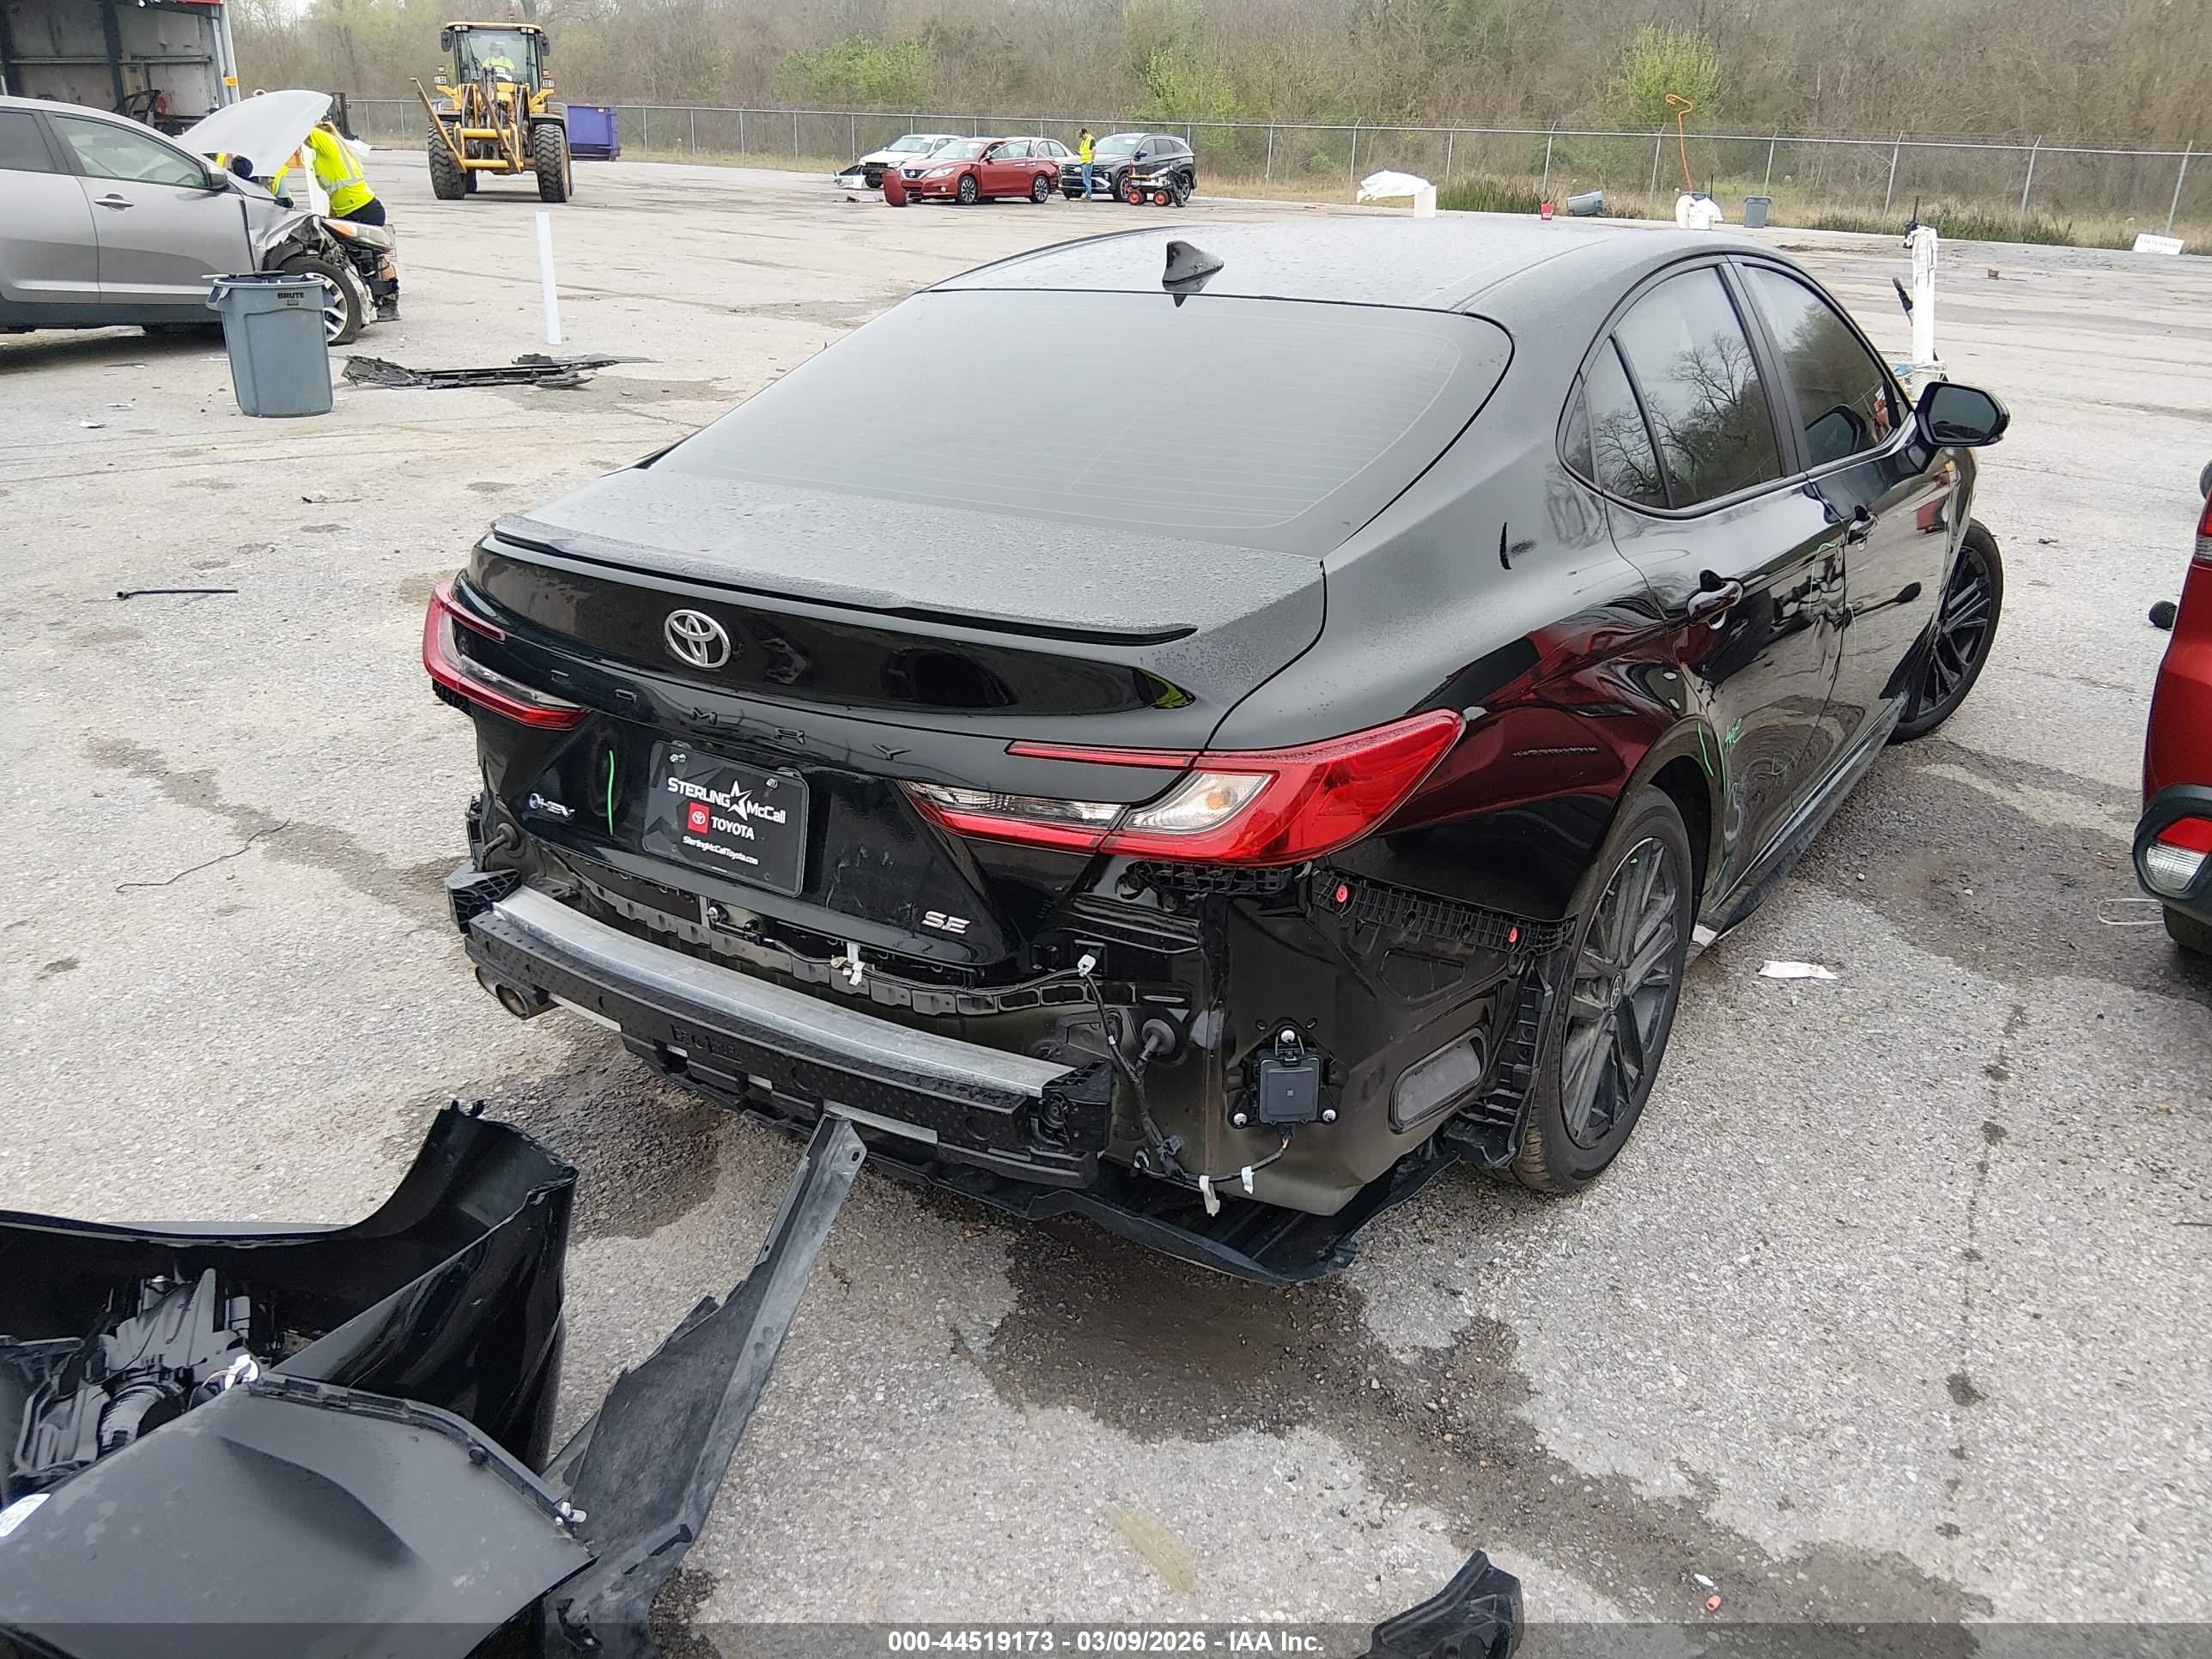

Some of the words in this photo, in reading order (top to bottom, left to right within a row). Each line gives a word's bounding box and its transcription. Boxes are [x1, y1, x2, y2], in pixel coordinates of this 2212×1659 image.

[667, 776, 731, 808] STERLING
[747, 799, 787, 824] McCall
[711, 816, 755, 841] TOYOTA
[921, 910, 970, 935] SE
